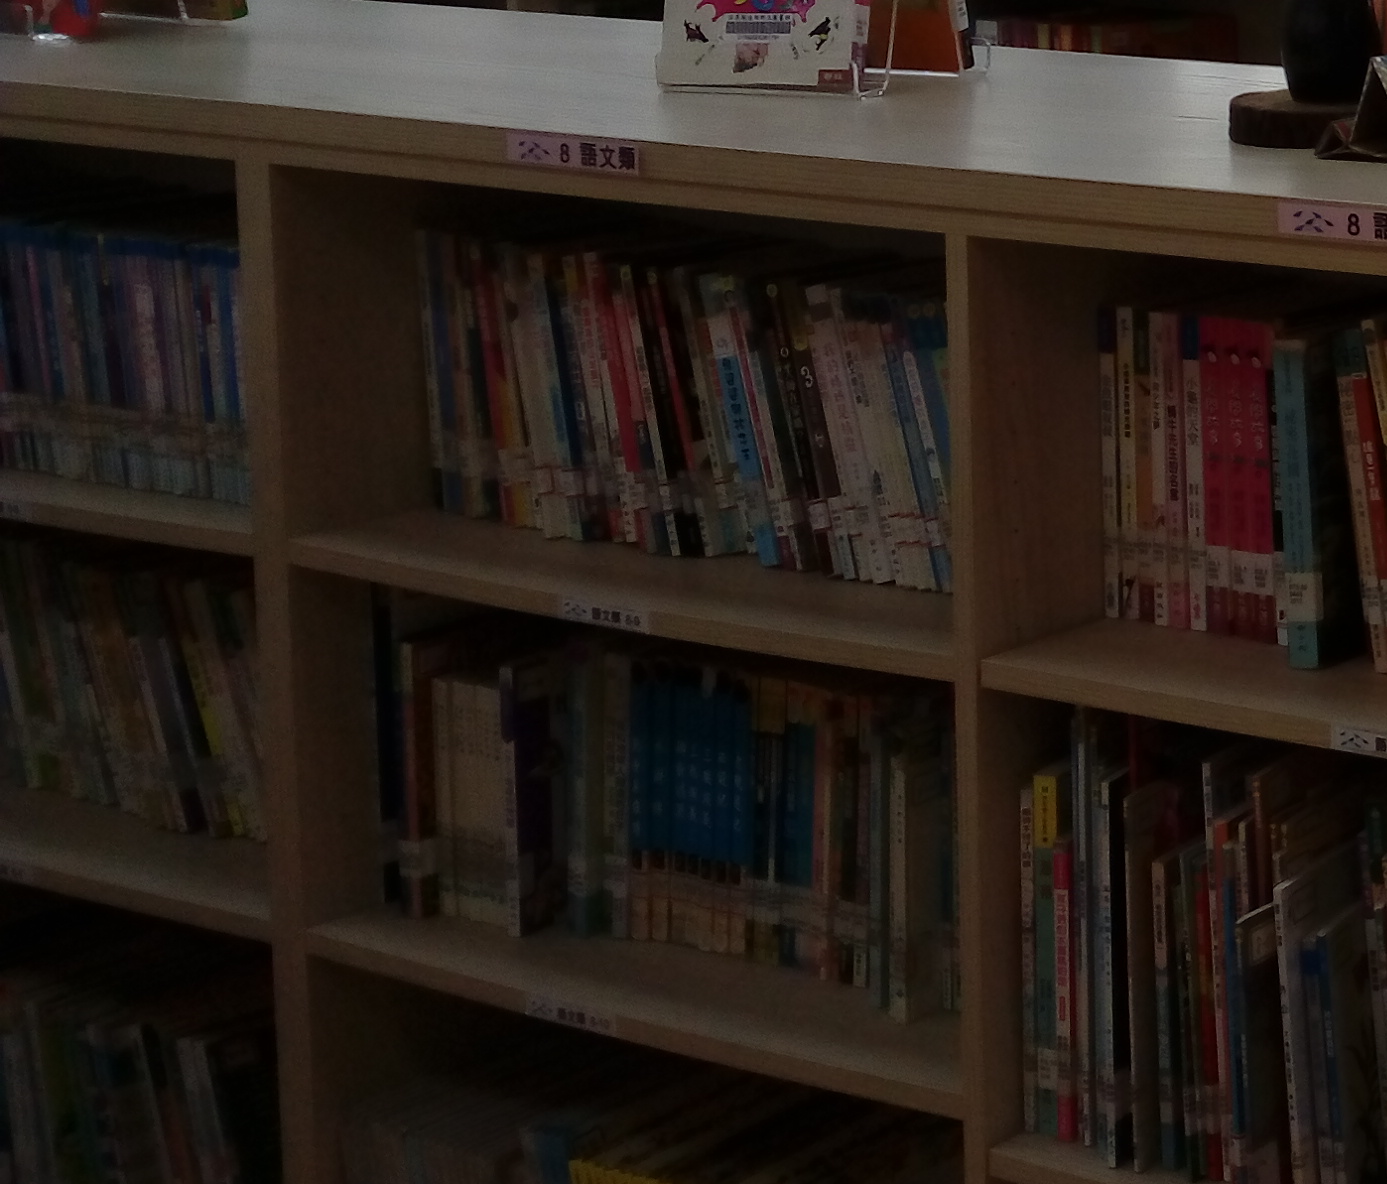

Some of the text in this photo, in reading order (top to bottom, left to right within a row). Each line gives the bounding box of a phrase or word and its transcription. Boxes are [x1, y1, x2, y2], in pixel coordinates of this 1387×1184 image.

[560, 142, 635, 170] 8 語文類
[1347, 213, 1360, 236] 8
